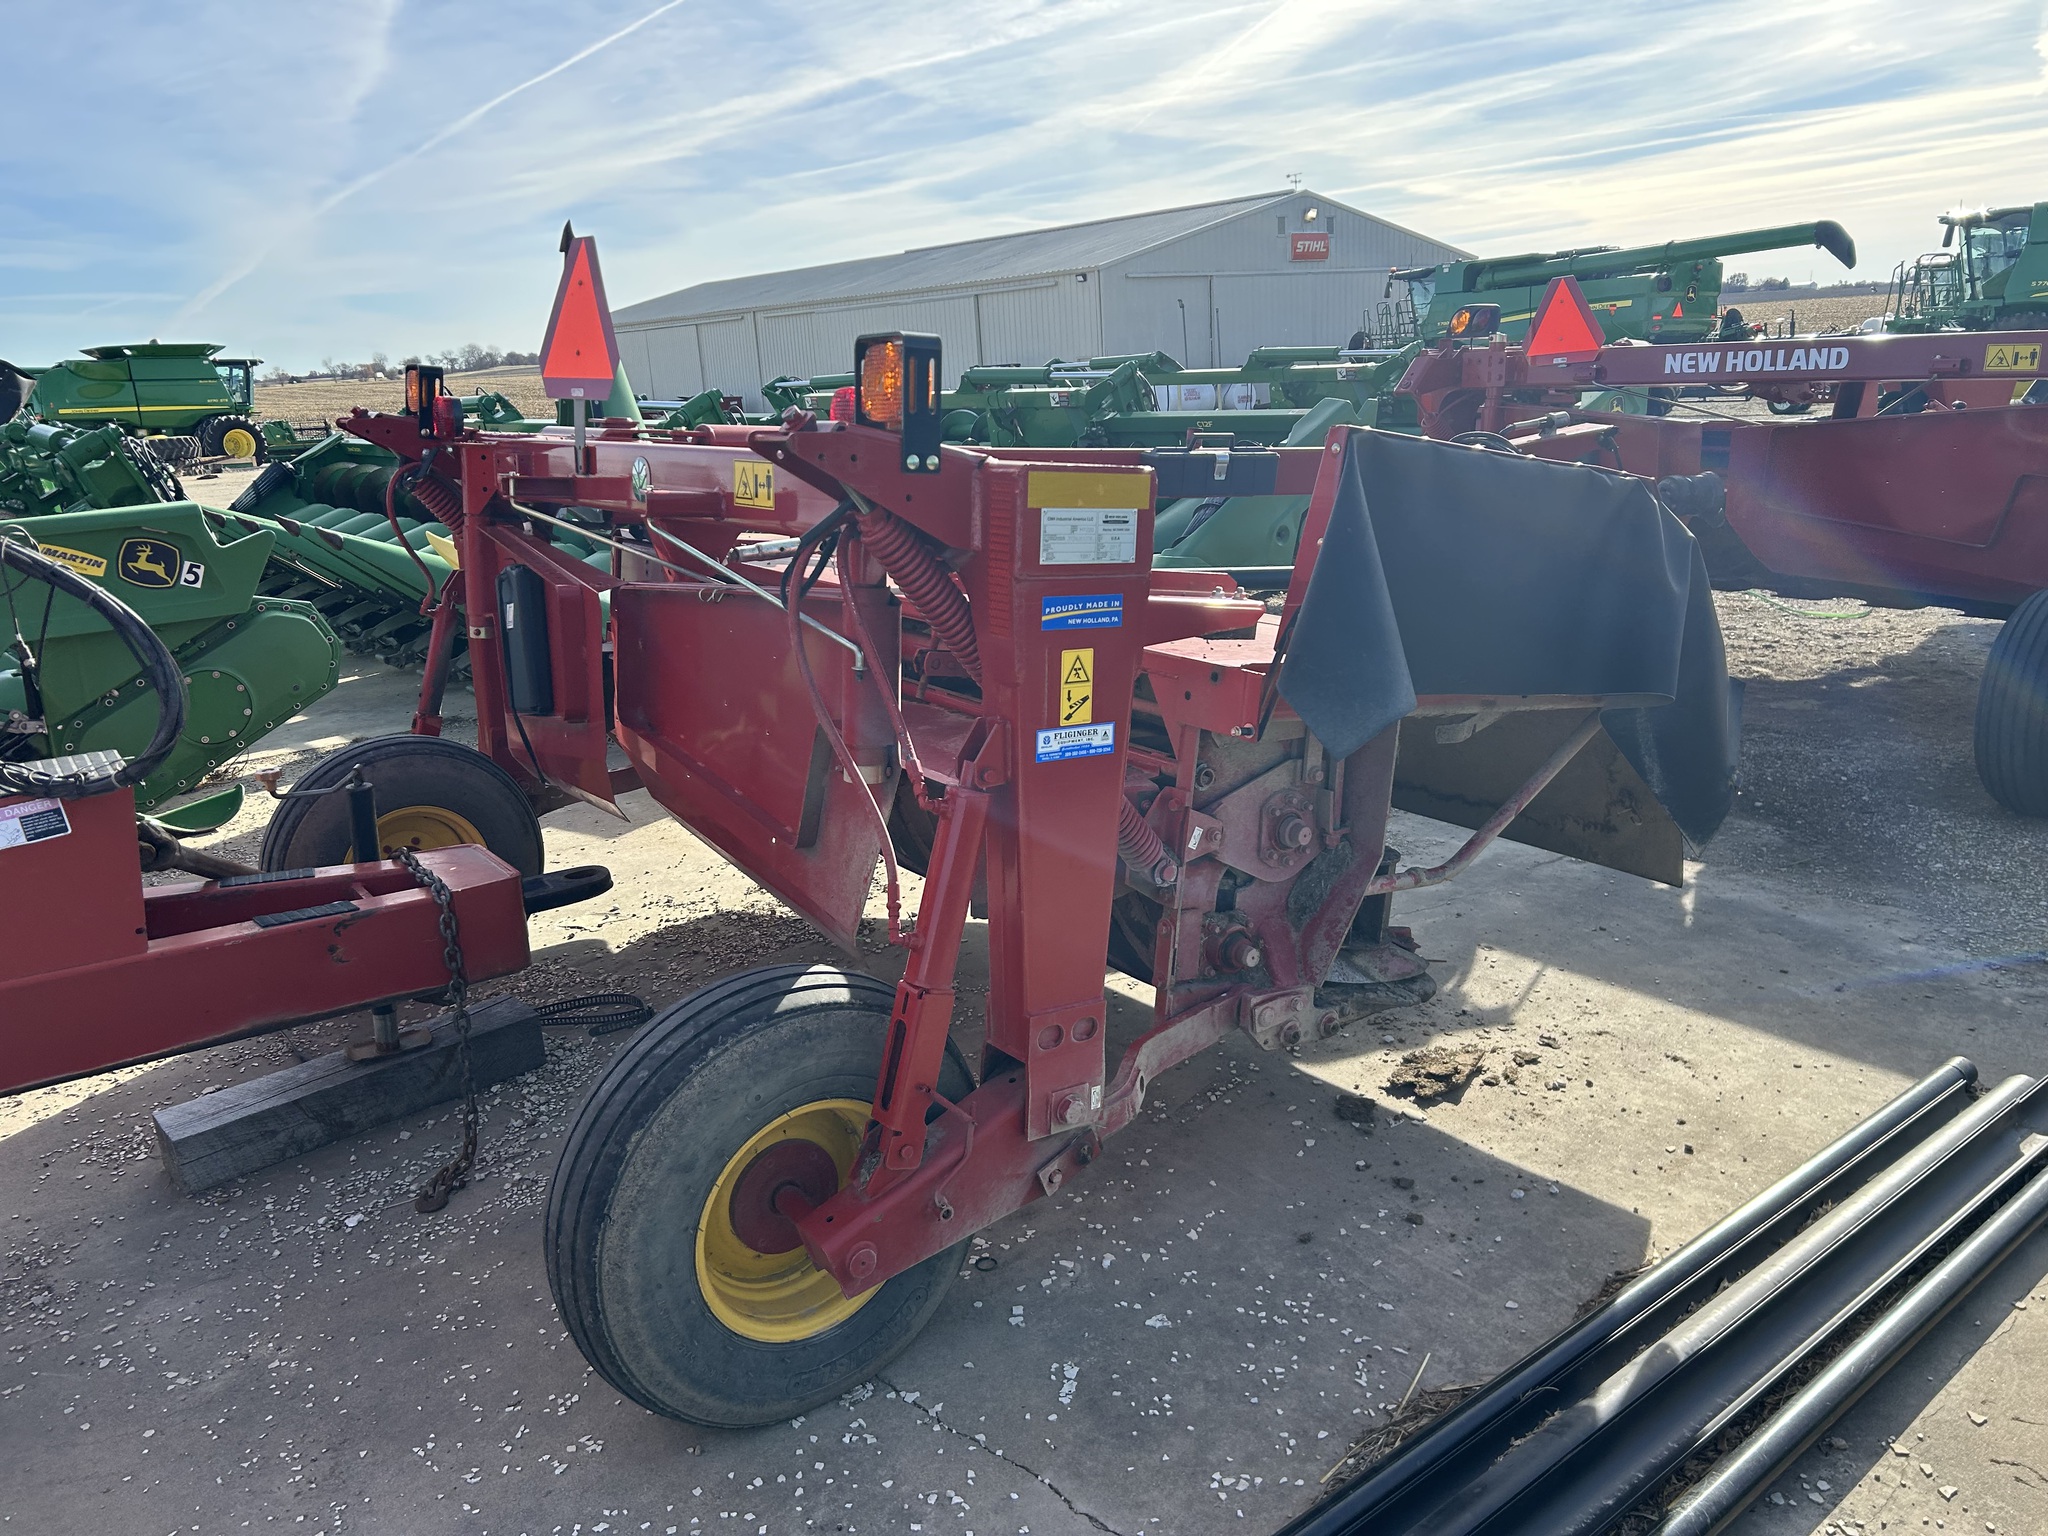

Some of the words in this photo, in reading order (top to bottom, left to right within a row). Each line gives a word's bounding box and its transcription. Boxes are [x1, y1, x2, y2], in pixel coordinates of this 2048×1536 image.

[1295, 240, 1327, 253] STIHL
[1664, 351, 1721, 374] NEW
[1725, 347, 1850, 373] HOLLAND
[43, 546, 105, 569] MARTIN
[183, 563, 201, 585] 5
[1045, 602, 1084, 615] PROUDLY
[1086, 600, 1109, 609] MADE
[1053, 728, 1099, 740] FLIGINGER
[4, 799, 52, 818] DANGER
